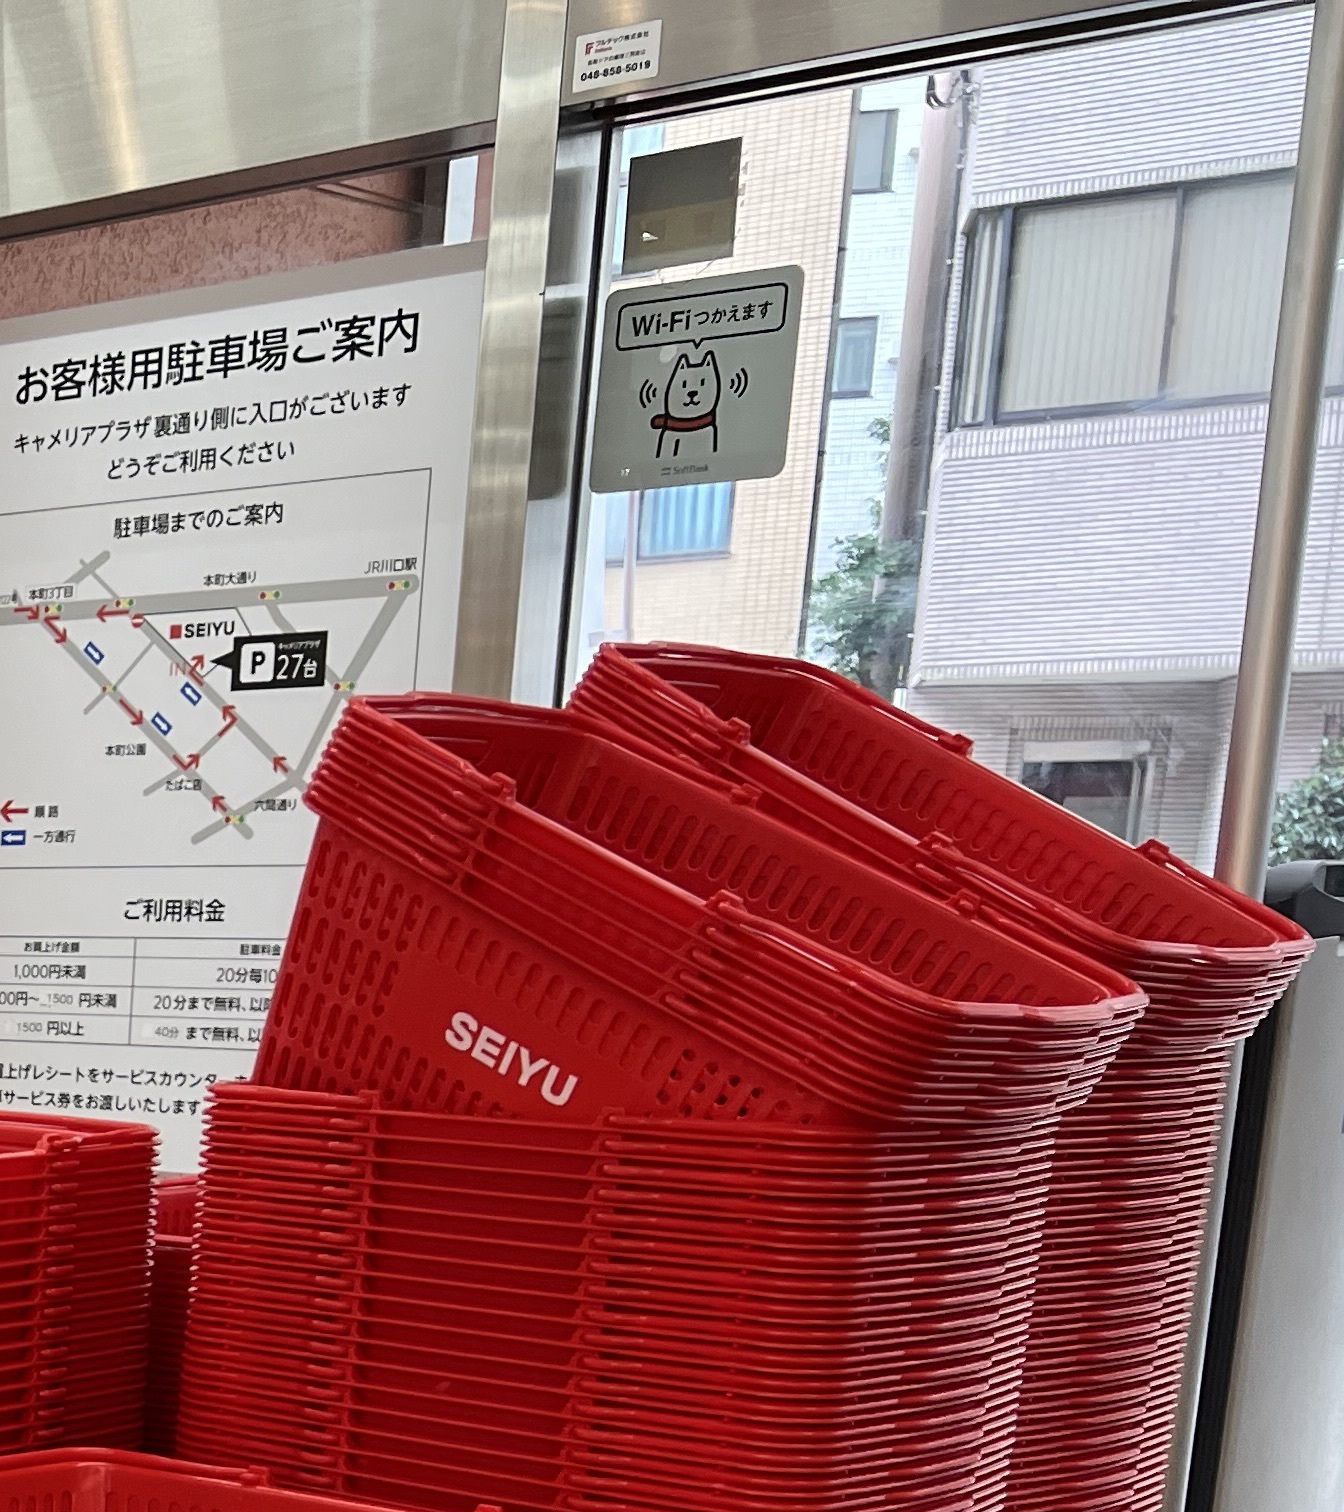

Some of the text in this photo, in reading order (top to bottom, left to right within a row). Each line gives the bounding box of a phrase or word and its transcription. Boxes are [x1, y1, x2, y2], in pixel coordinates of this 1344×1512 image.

[632, 300, 774, 339] Wi-Fiつかえます
[15, 308, 420, 406] お客様用駐車場ご案内
[106, 438, 295, 480] どうぞご利用ください
[113, 502, 285, 539] 駐車場までのご案内
[363, 557, 418, 574] JR川口駅
[202, 571, 257, 587] 本町大通り
[184, 621, 235, 638] SEIYU
[169, 662, 187, 677] IN
[250, 650, 266, 675] P
[276, 653, 318, 680] 27台
[124, 898, 226, 923] ご利用料金
[14, 963, 87, 980] 1,000円未満
[216, 968, 278, 984] 20分毎10
[78, 993, 117, 1009] 円未満
[46, 1020, 85, 1037] 円以上
[444, 1010, 579, 1107] SEIYU
